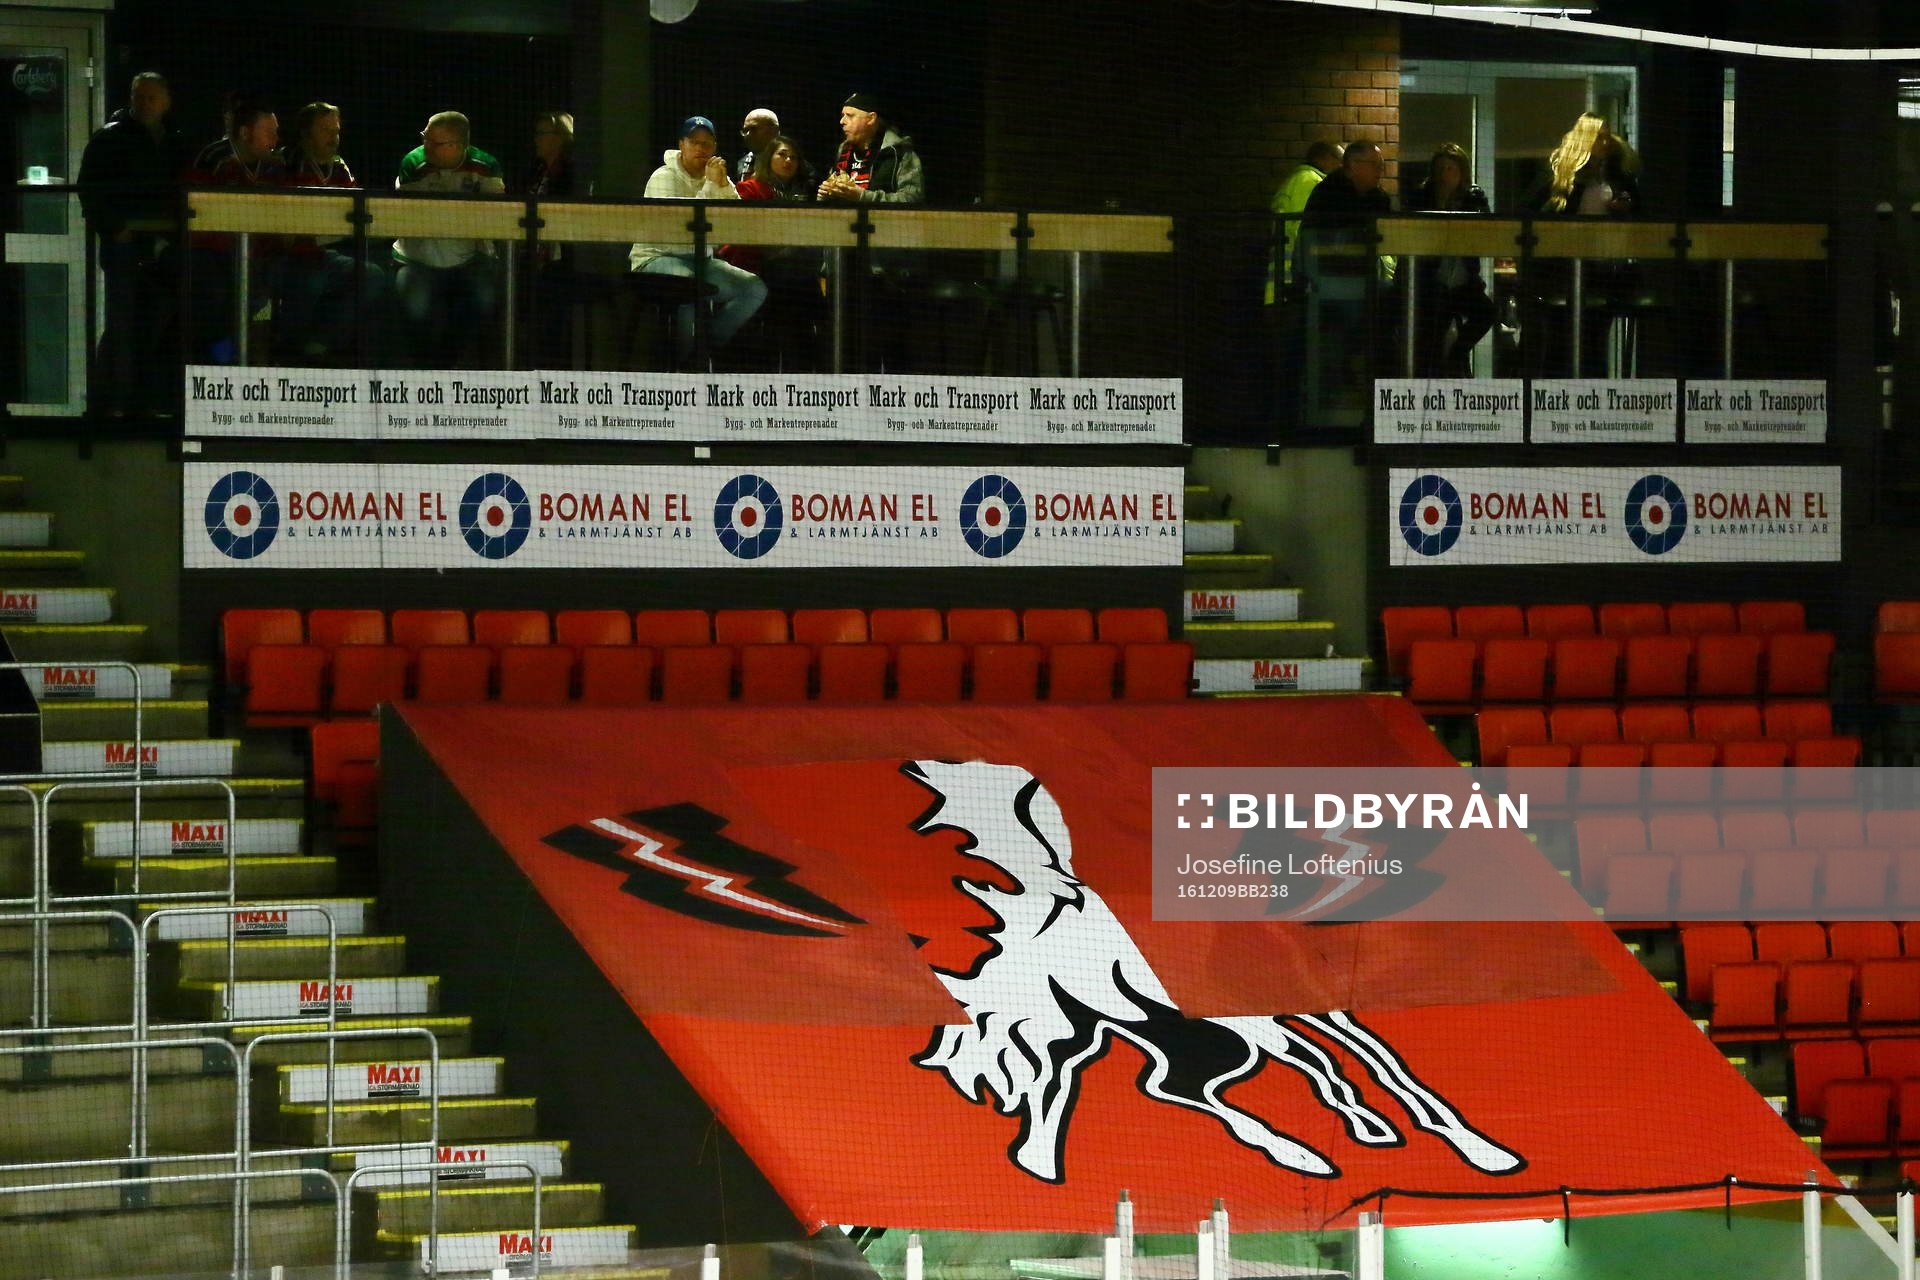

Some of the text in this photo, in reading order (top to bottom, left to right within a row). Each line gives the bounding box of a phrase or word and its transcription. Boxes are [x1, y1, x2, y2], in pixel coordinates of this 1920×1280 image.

[193, 377, 357, 407] Mark och Transport
[369, 381, 529, 409] Mark och Transport
[540, 381, 696, 410] Mark och Transport
[707, 384, 858, 411] Mark och Transport
[869, 385, 1018, 414] Mark och Transport
[1030, 388, 1176, 415] Mark och Transport
[1380, 389, 1519, 414] Mark och Transport
[1534, 389, 1672, 414] Mark och Transport
[1687, 390, 1825, 415] Mark och Transport
[212, 412, 334, 426] Bygg- och Markentreprenader
[388, 415, 507, 428] Bygg- och Markentreprenader
[558, 415, 675, 429] Bygg- och Markentreprenader
[725, 418, 838, 430] Bygg- och Markentreprenader
[888, 418, 998, 432] Bygg- och Markentreprenader
[1048, 421, 1155, 433] Bygg- och Markentreprenader
[289, 492, 447, 520] BOMAN EL
[540, 494, 691, 521] BOMAN EL
[791, 494, 937, 521] BOMAN EL
[1035, 494, 1176, 520] BOMAN EL
[1471, 492, 1606, 520] BOMAN EL
[1695, 492, 1828, 519] BOMAN EL
[288, 523, 447, 537] & LARMTJÄNST AB
[539, 524, 692, 538] & LARMTJÄNST AB
[791, 525, 938, 538] & LARMTJÄNST AB
[1034, 524, 1177, 537] & LARMTJÄNST AB
[1470, 521, 1607, 535] & LARMTJÄNST AB
[1694, 522, 1828, 534] & LARMTJÄNST AB
[0, 589, 37, 610] AXI
[1191, 592, 1236, 610] MAXI
[44, 667, 96, 685] MAXI
[1254, 660, 1298, 678] MAXI
[105, 743, 158, 763] MAXI
[171, 821, 224, 842] MAXI
[300, 982, 352, 1001] MAXI
[367, 1064, 420, 1085] MAXI
